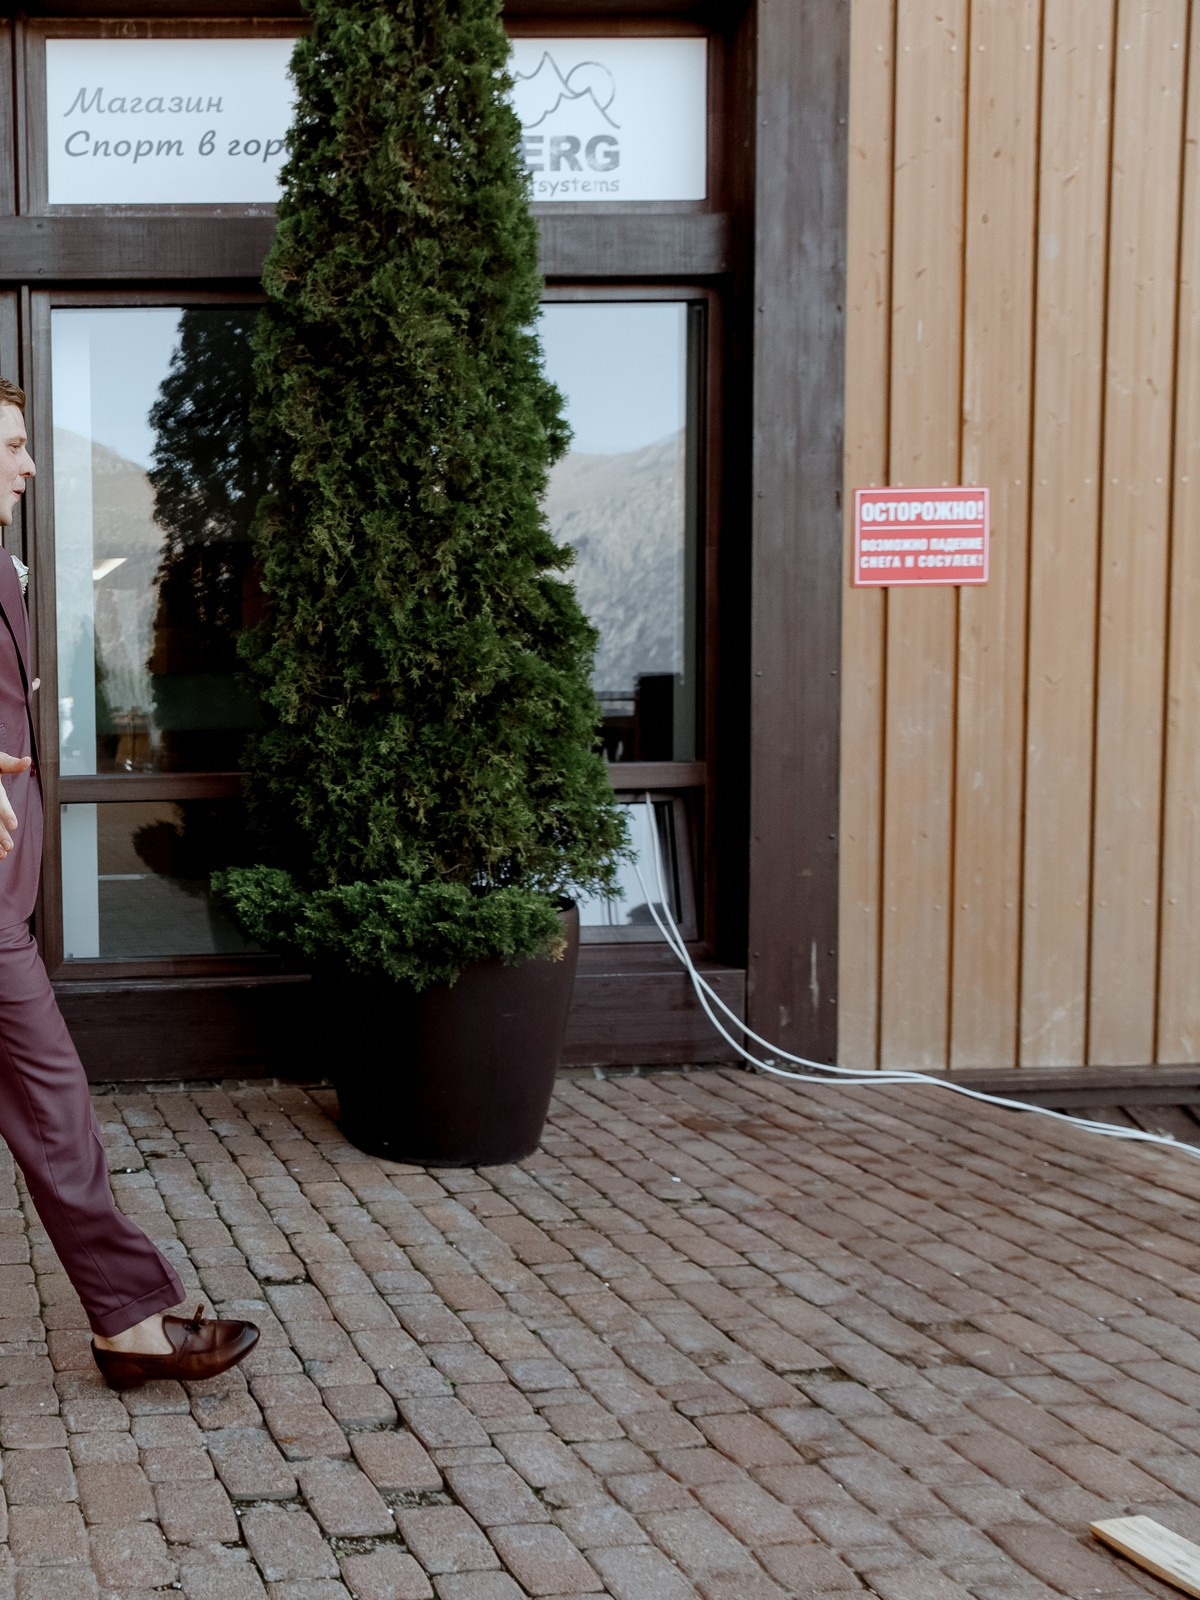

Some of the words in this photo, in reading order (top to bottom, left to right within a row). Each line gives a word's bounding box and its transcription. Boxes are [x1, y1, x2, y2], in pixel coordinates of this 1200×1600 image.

[63, 87, 224, 117] Магазин
[64, 130, 184, 163] Спорт
[198, 129, 217, 156] в
[518, 134, 620, 172] ERG
[532, 178, 620, 197] systems
[861, 500, 984, 522] ОСТОРОЖНО!
[860, 555, 902, 568] СНЕГА
[904, 555, 915, 568] И
